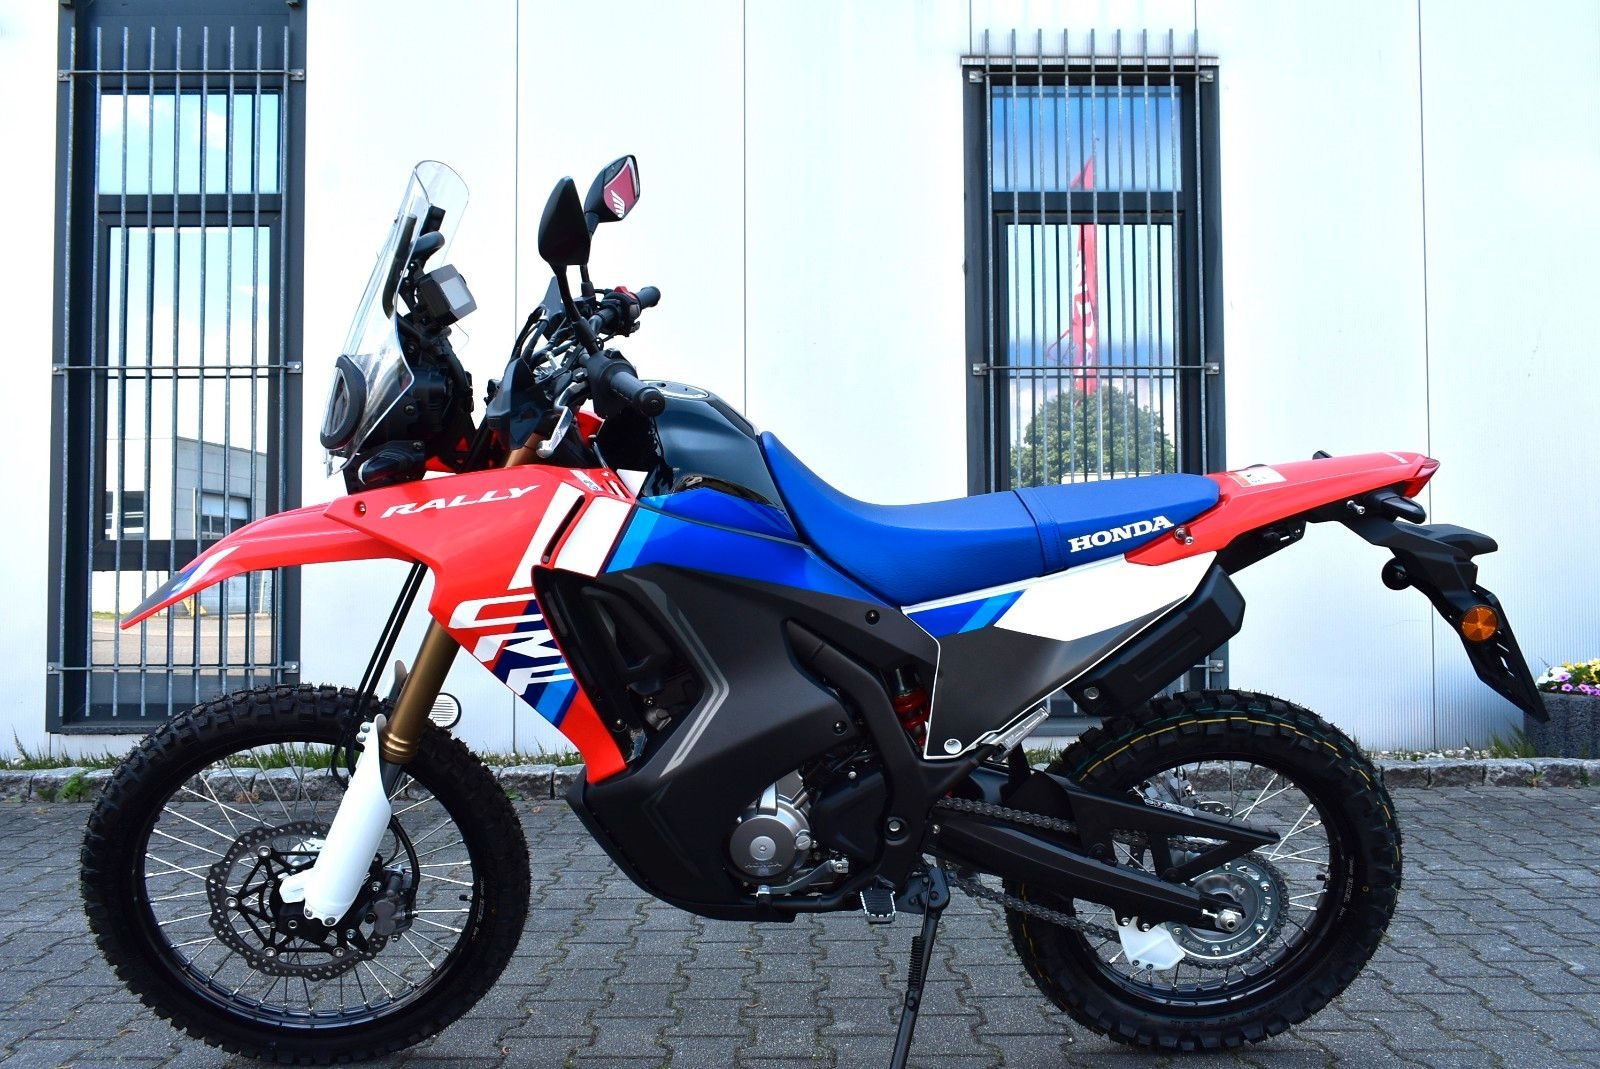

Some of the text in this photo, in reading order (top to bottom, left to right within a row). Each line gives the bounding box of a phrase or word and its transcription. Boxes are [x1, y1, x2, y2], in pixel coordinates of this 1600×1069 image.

[380, 485, 541, 518] RALLY
[1068, 515, 1175, 552] HONDA
[448, 593, 575, 696] CRF
